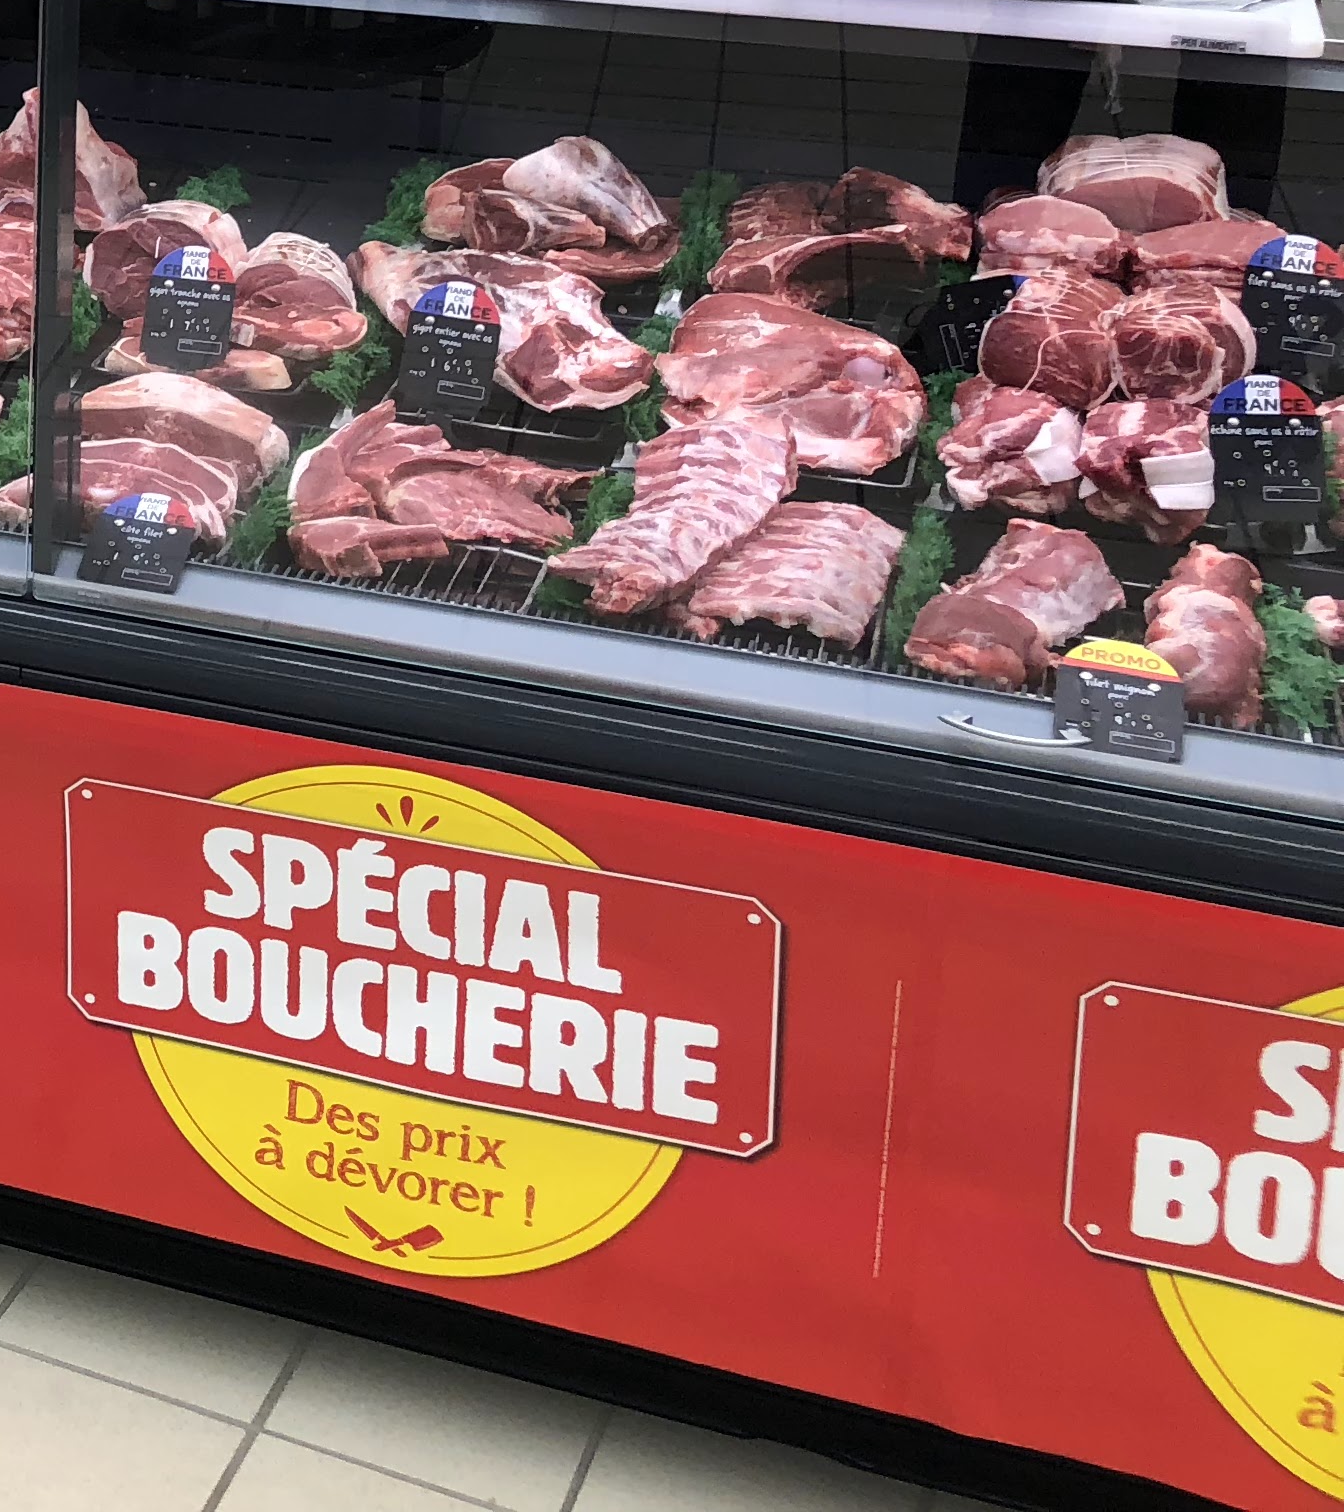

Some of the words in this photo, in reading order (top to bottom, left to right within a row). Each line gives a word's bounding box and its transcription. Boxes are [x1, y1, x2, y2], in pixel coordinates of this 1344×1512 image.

[163, 263, 227, 280] FRANCE
[1261, 255, 1337, 276] FRANCE
[424, 298, 492, 319] FRANCE
[1224, 398, 1306, 412] FRANCE
[1081, 647, 1161, 671] PROMO
[202, 825, 622, 995] SPÉCIAL
[116, 910, 719, 1125] BOUCHERIE
[1253, 1039, 1344, 1154] S
[284, 1078, 381, 1143] Des
[400, 1117, 507, 1171] prix
[254, 1123, 288, 1171] à
[305, 1143, 504, 1220] dévorer
[1297, 1380, 1337, 1433] à
